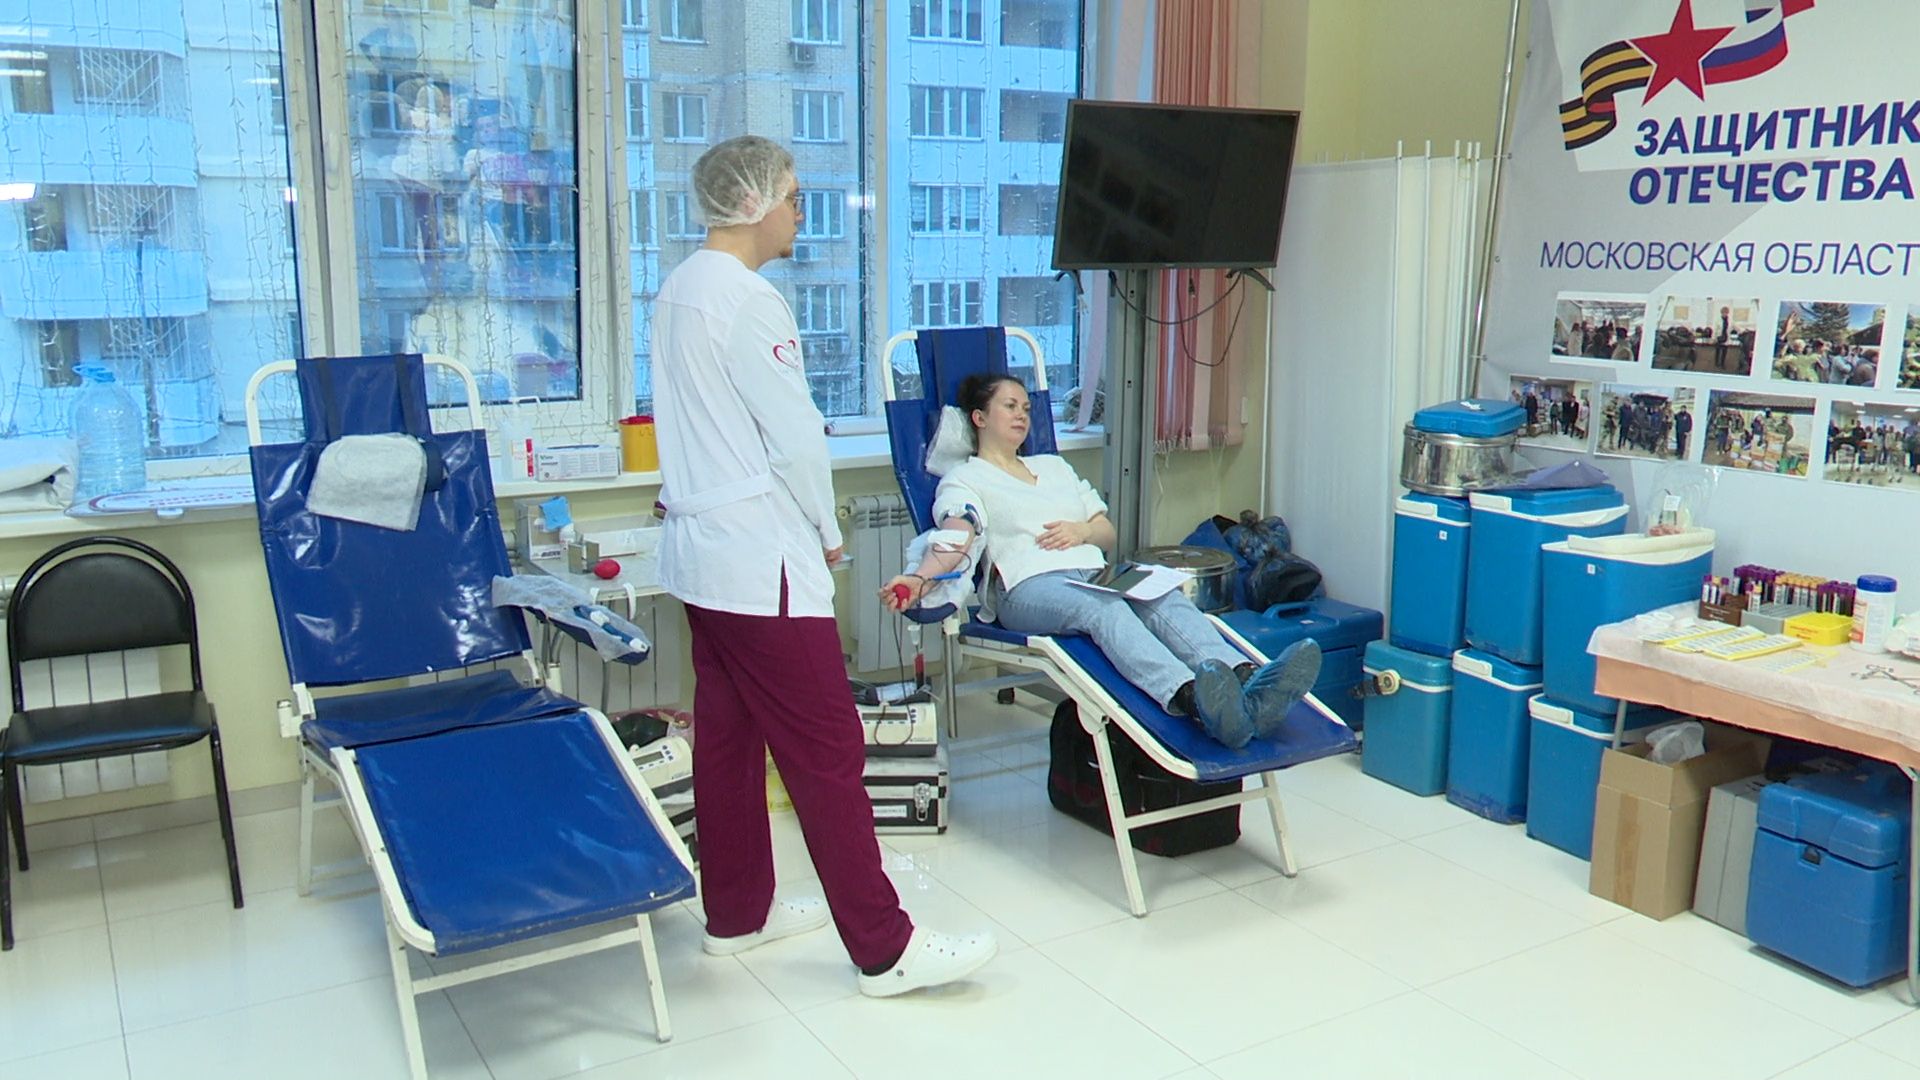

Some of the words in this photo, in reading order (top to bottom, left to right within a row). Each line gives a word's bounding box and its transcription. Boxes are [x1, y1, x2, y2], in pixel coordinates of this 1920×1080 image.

[1635, 101, 1920, 157] ЗАЩИТНИК
[1629, 157, 1914, 204] ОТЕЧЕСТВА
[1540, 241, 1755, 273] МОСКОВСКАЯ
[1763, 242, 1920, 276] ОБЛАСТ
